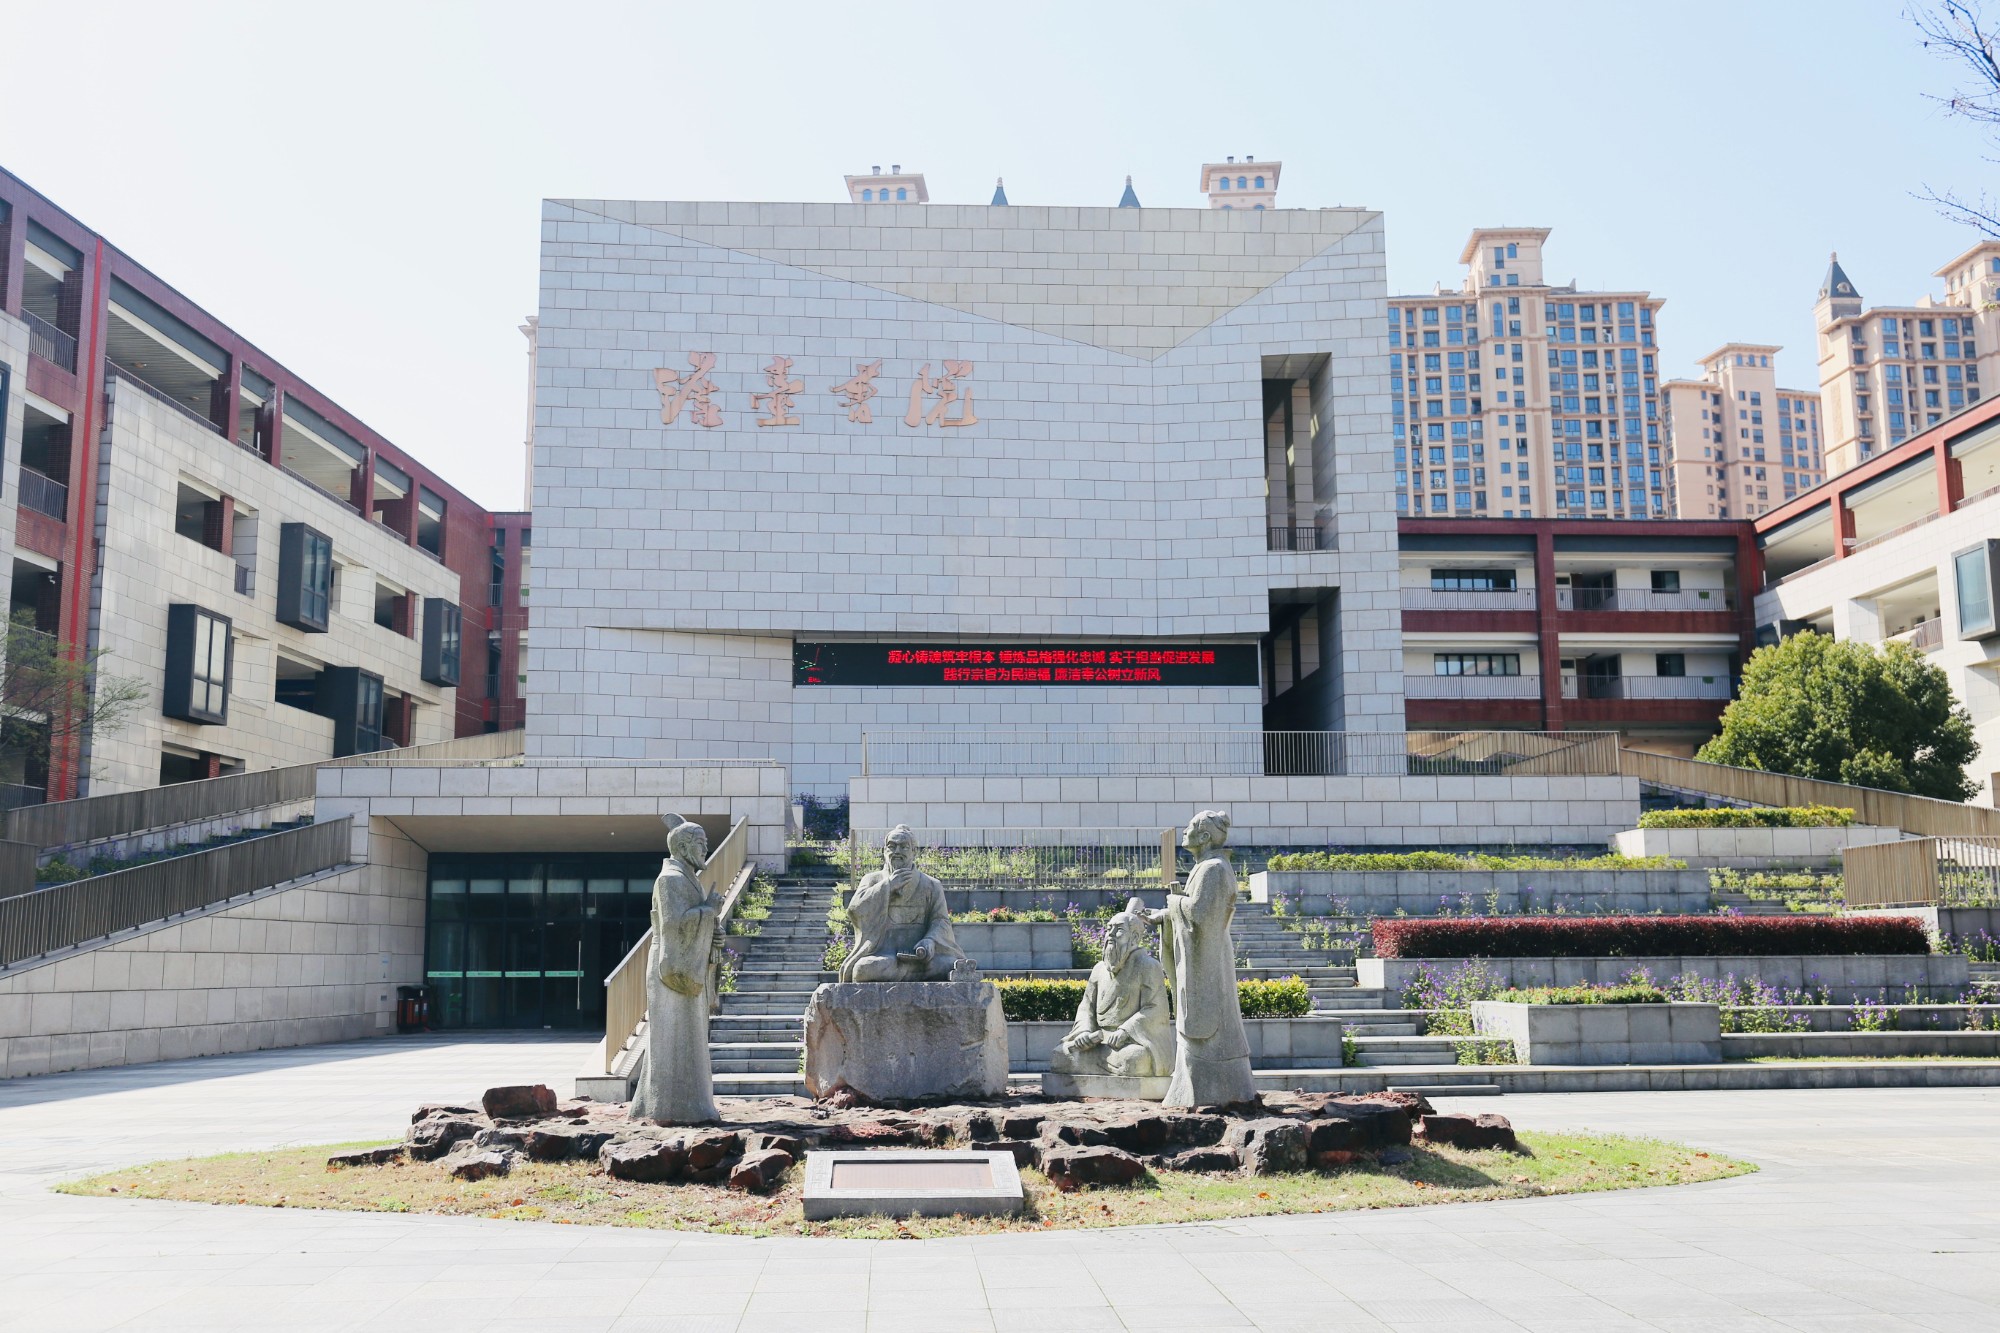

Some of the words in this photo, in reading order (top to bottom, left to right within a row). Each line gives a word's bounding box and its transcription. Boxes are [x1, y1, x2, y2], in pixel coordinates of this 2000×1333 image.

[887, 650, 995, 664] 凝心铸魂筑牢根本
[998, 650, 1106, 664] 锤炼品格强化忠诚
[1109, 650, 1215, 664] 实干担当促进发展
[943, 667, 1051, 681] 践行宗旨为民造福
[1054, 667, 1161, 681] 廉洁奉公树立新风
